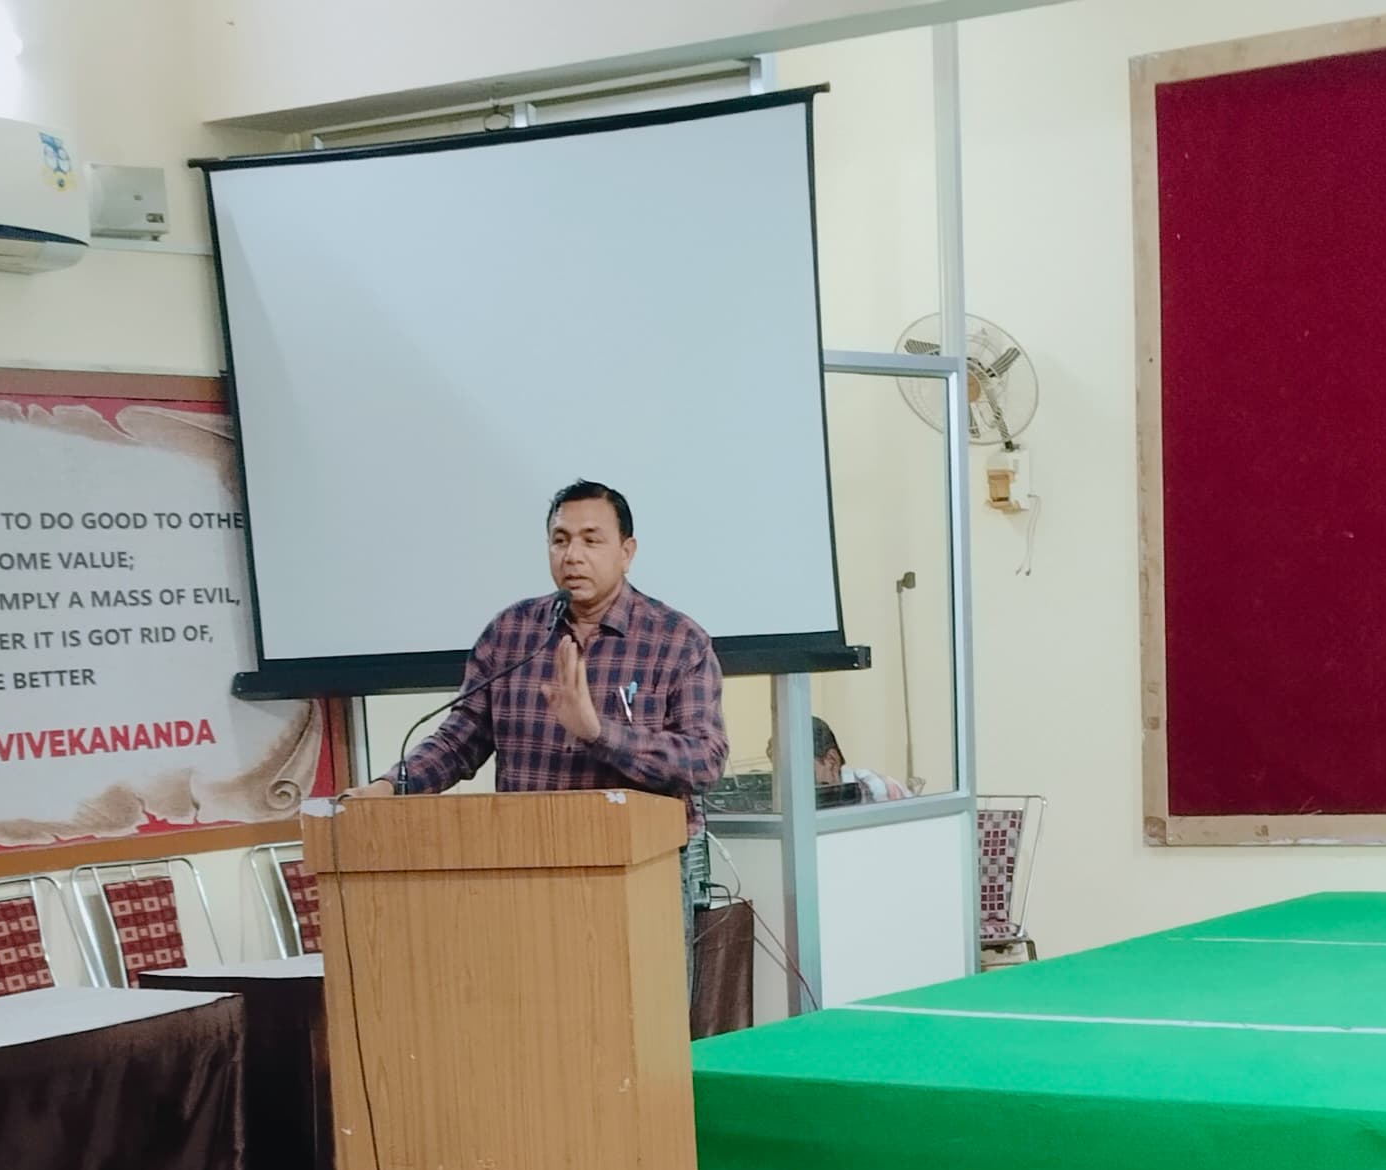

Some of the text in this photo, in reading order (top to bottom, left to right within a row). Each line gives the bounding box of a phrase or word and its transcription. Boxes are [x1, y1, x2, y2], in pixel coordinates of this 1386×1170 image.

[0, 511, 32, 530] TO
[40, 511, 75, 530] DO
[80, 511, 148, 530] GOOD
[153, 512, 182, 530] TO
[57, 551, 135, 571] VALUE;
[68, 591, 85, 609] A
[90, 589, 153, 608] MASS
[158, 588, 187, 606] OF
[193, 587, 242, 607] EVIL,
[33, 630, 55, 649] IT
[61, 629, 82, 648] IS
[87, 627, 133, 647] GOT
[140, 625, 177, 644] RID
[182, 624, 214, 643] OF,
[13, 668, 97, 690] BETTER
